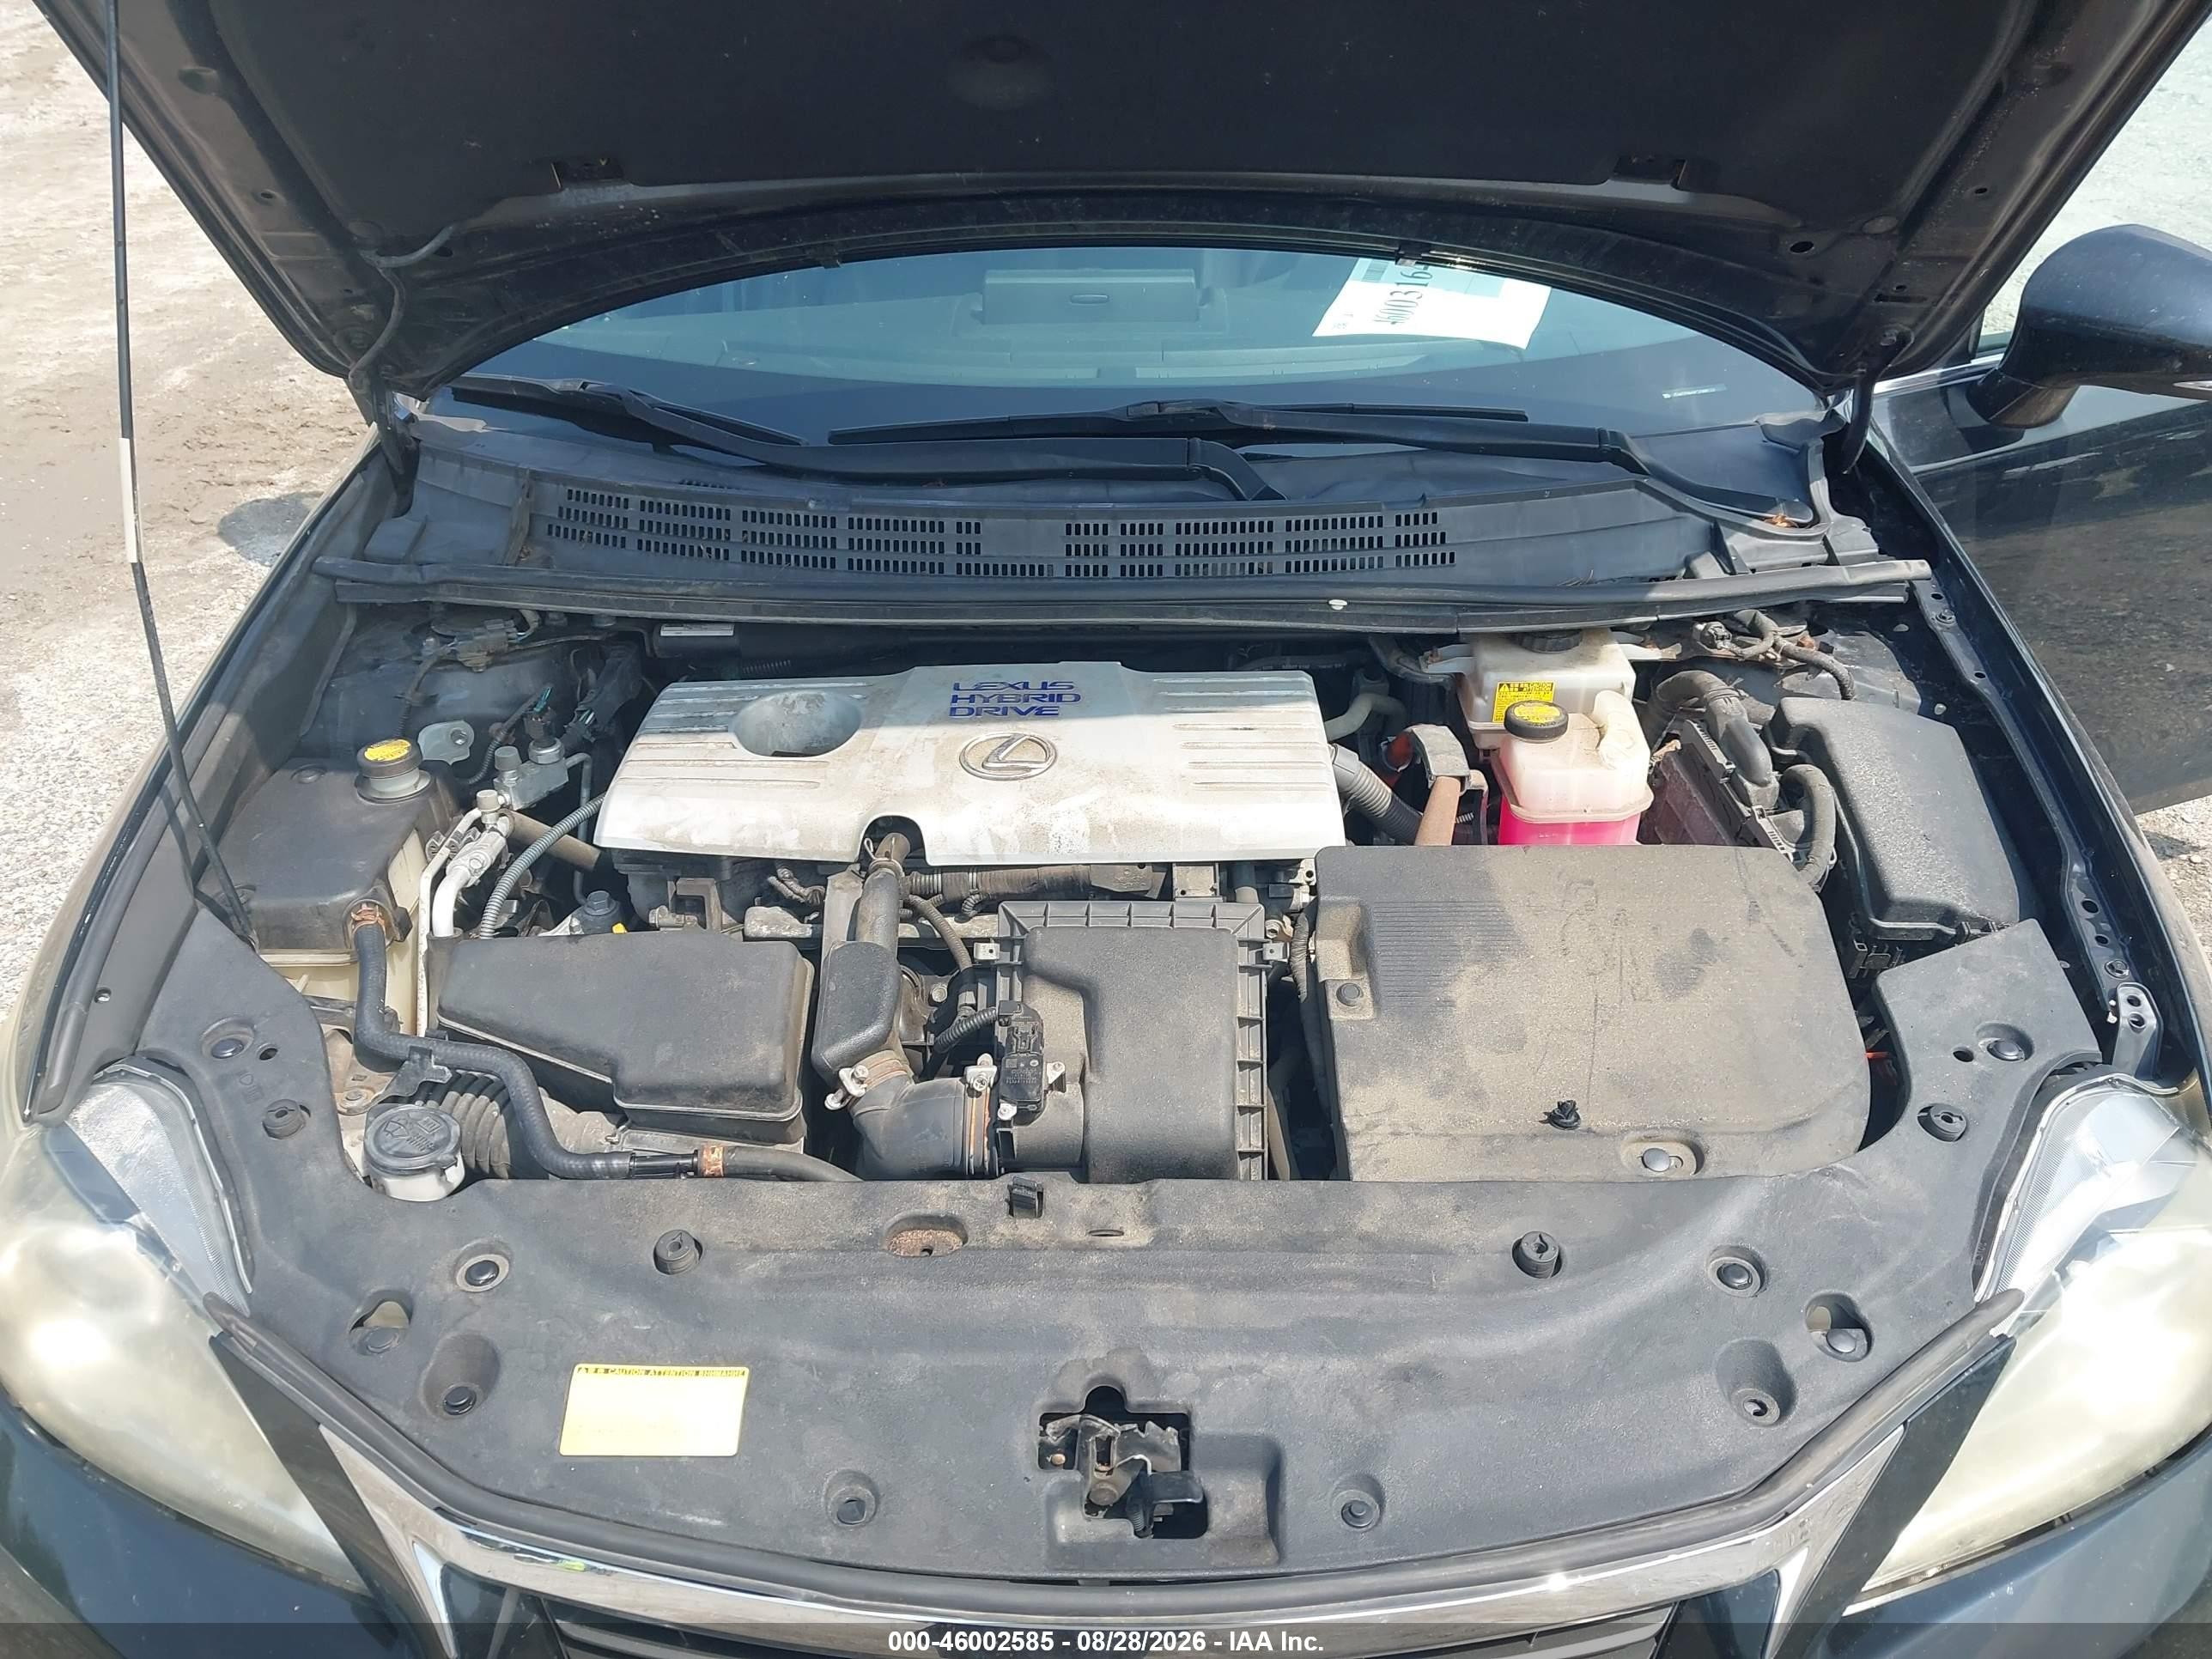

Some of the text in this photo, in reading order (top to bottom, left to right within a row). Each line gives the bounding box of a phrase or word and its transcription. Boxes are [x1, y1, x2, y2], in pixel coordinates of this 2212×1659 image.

[953, 681, 1075, 691] LEXUS
[951, 693, 1082, 703] HYBRID
[949, 706, 1060, 717] DRIVE
